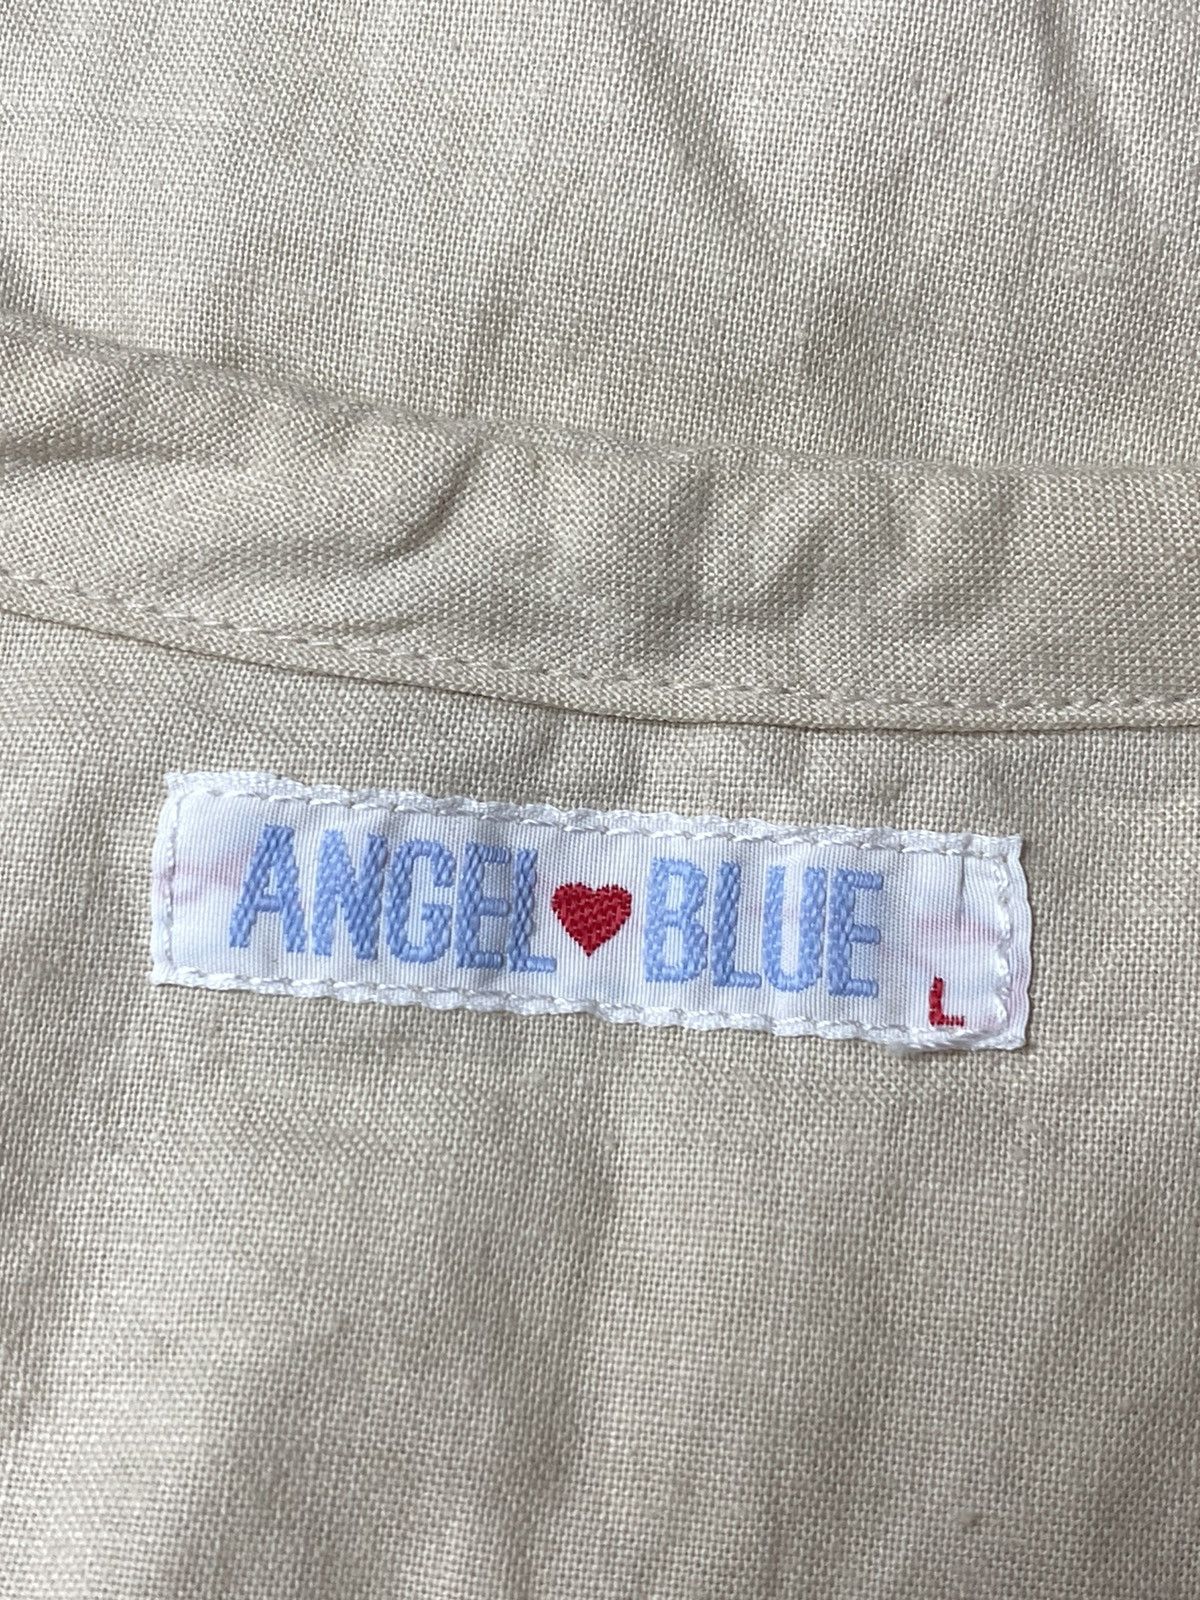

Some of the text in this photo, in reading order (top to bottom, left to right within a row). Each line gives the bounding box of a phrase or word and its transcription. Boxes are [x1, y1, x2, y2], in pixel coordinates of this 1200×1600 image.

[229, 823, 884, 997] ANGEL BLUE
[928, 977, 965, 1028] L
